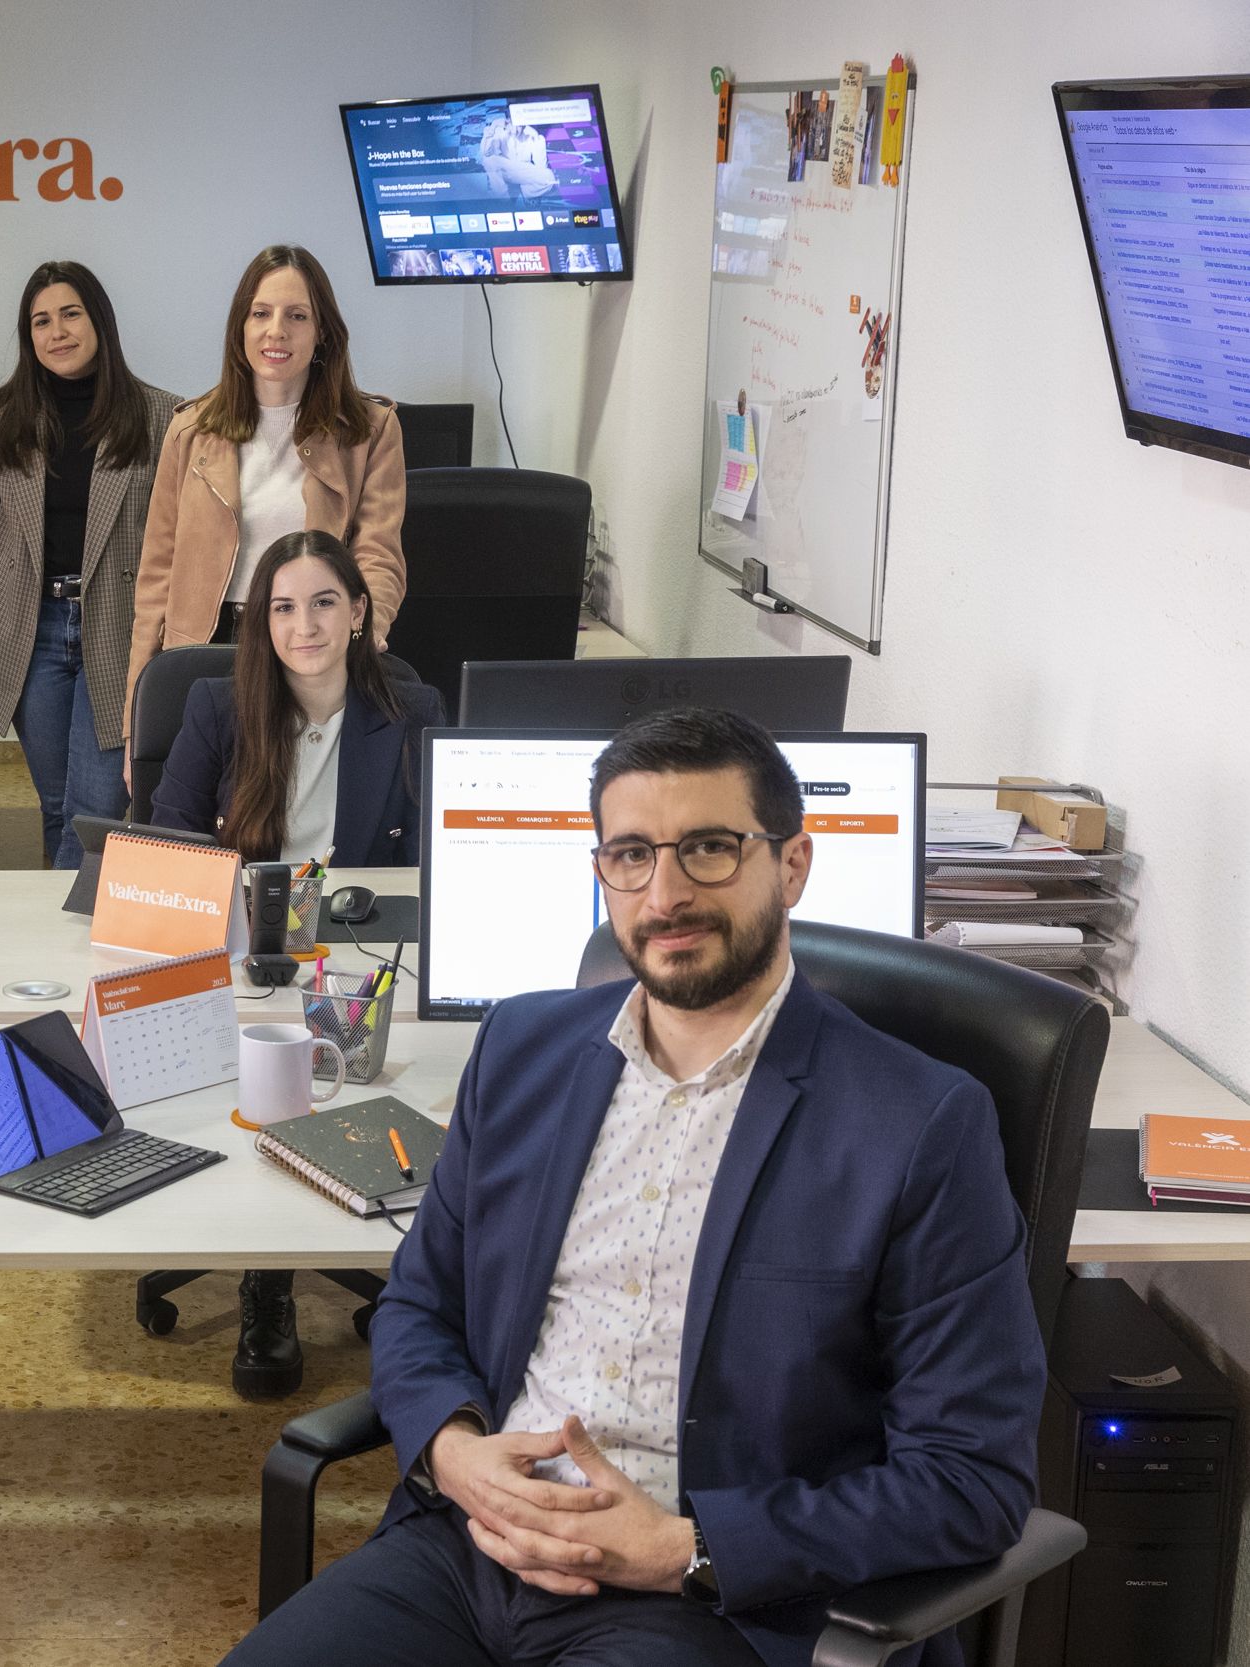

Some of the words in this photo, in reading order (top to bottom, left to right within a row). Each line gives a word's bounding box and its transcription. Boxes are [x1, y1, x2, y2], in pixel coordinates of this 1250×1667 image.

[367, 151, 392, 161] J-Hope
[392, 150, 399, 159] in
[399, 150, 411, 159] the
[411, 149, 425, 158] Box
[379, 184, 398, 192] Nuevas
[398, 183, 422, 191] funciones
[422, 181, 450, 190] disponibles
[501, 251, 541, 263] MOVIES
[500, 261, 545, 272] CENTRAL
[657, 680, 692, 700] LG
[107, 880, 221, 916] ValènciaExtra.
[212, 977, 227, 988] 2023
[102, 984, 141, 999] ValènciaExtra.
[103, 1000, 126, 1012] Març
